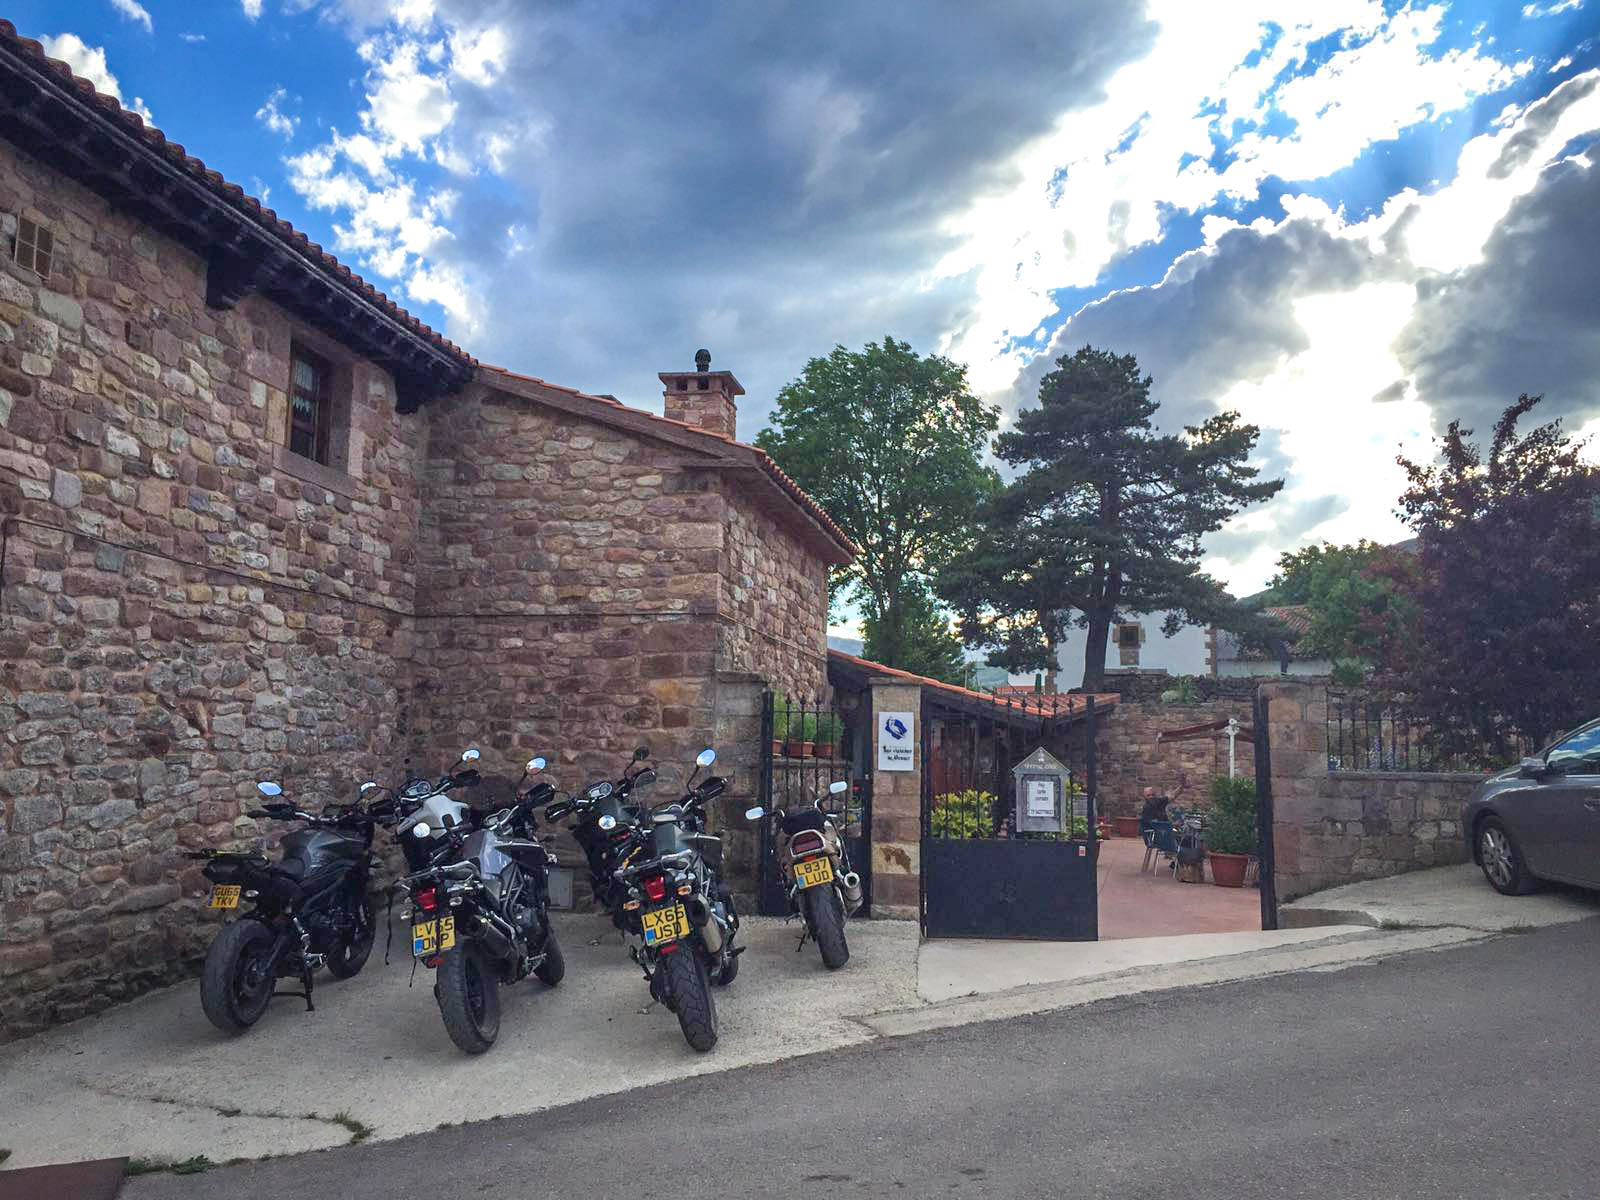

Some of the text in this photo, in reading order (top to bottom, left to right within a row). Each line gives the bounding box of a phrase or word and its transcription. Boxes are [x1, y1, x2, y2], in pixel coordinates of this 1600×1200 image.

[797, 858, 826, 875] L837
[805, 870, 829, 884] LUD
[654, 921, 682, 939] USD
